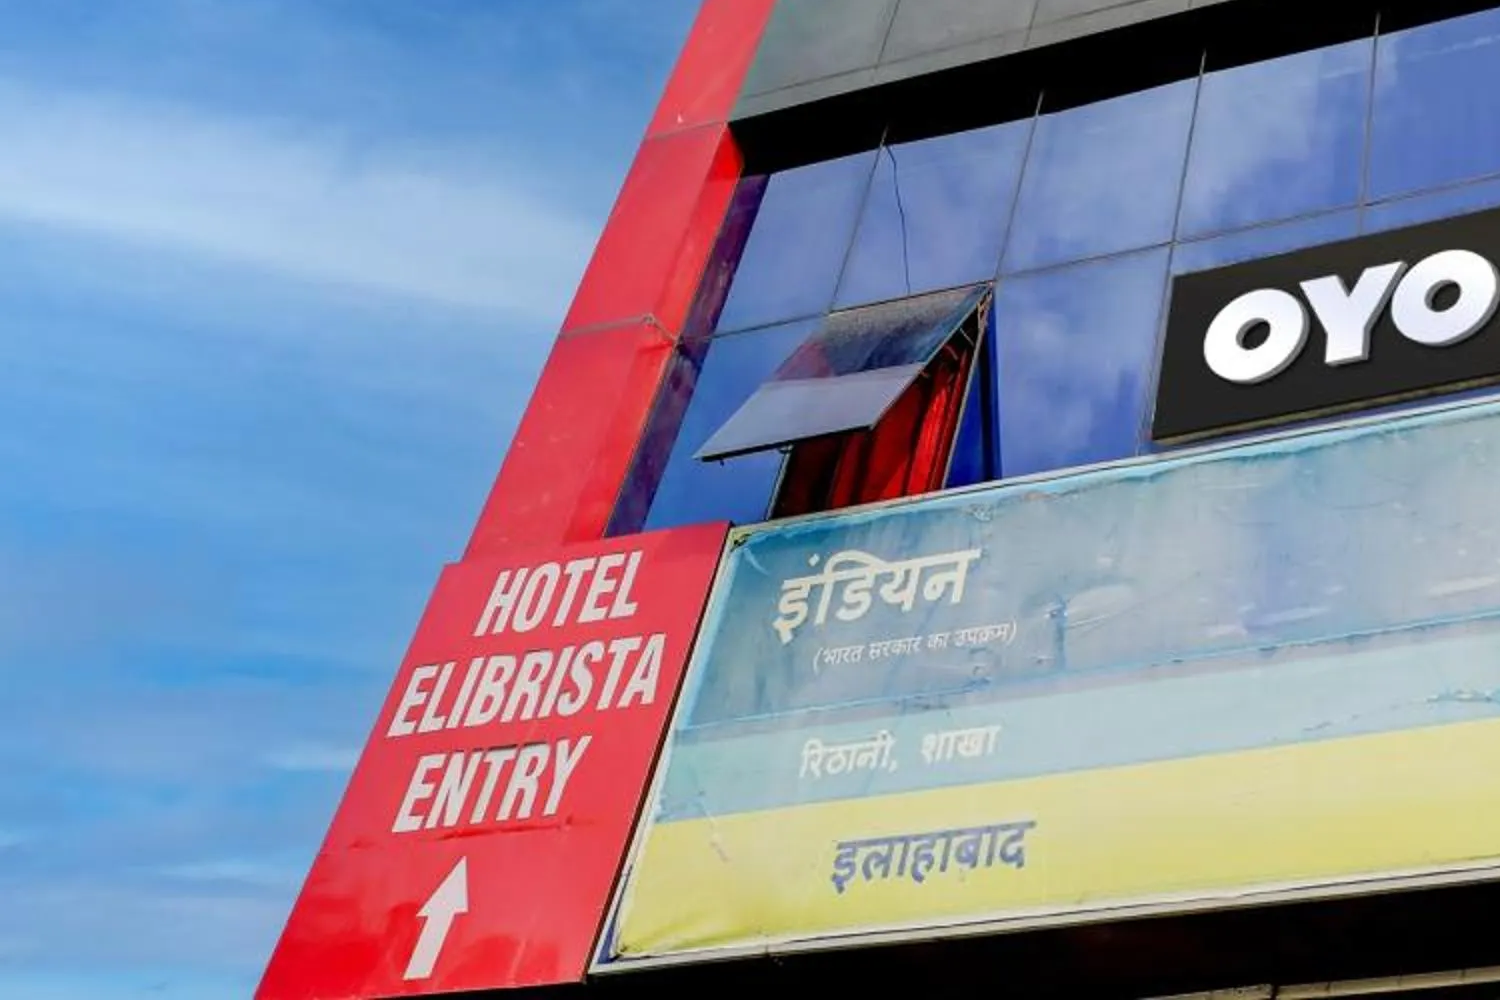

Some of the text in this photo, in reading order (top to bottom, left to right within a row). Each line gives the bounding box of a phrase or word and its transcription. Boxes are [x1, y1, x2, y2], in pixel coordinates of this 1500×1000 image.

[473, 551, 643, 637] HOTEL
[772, 548, 981, 644] इंडियन
[386, 632, 666, 738] ELIBRISTA
[868, 635, 923, 661] सरकार
[928, 632, 950, 650] का
[392, 735, 592, 833] ENTRY
[800, 725, 1002, 779] रिठानी, शाखा
[831, 819, 1037, 893] इलाहाबाद
